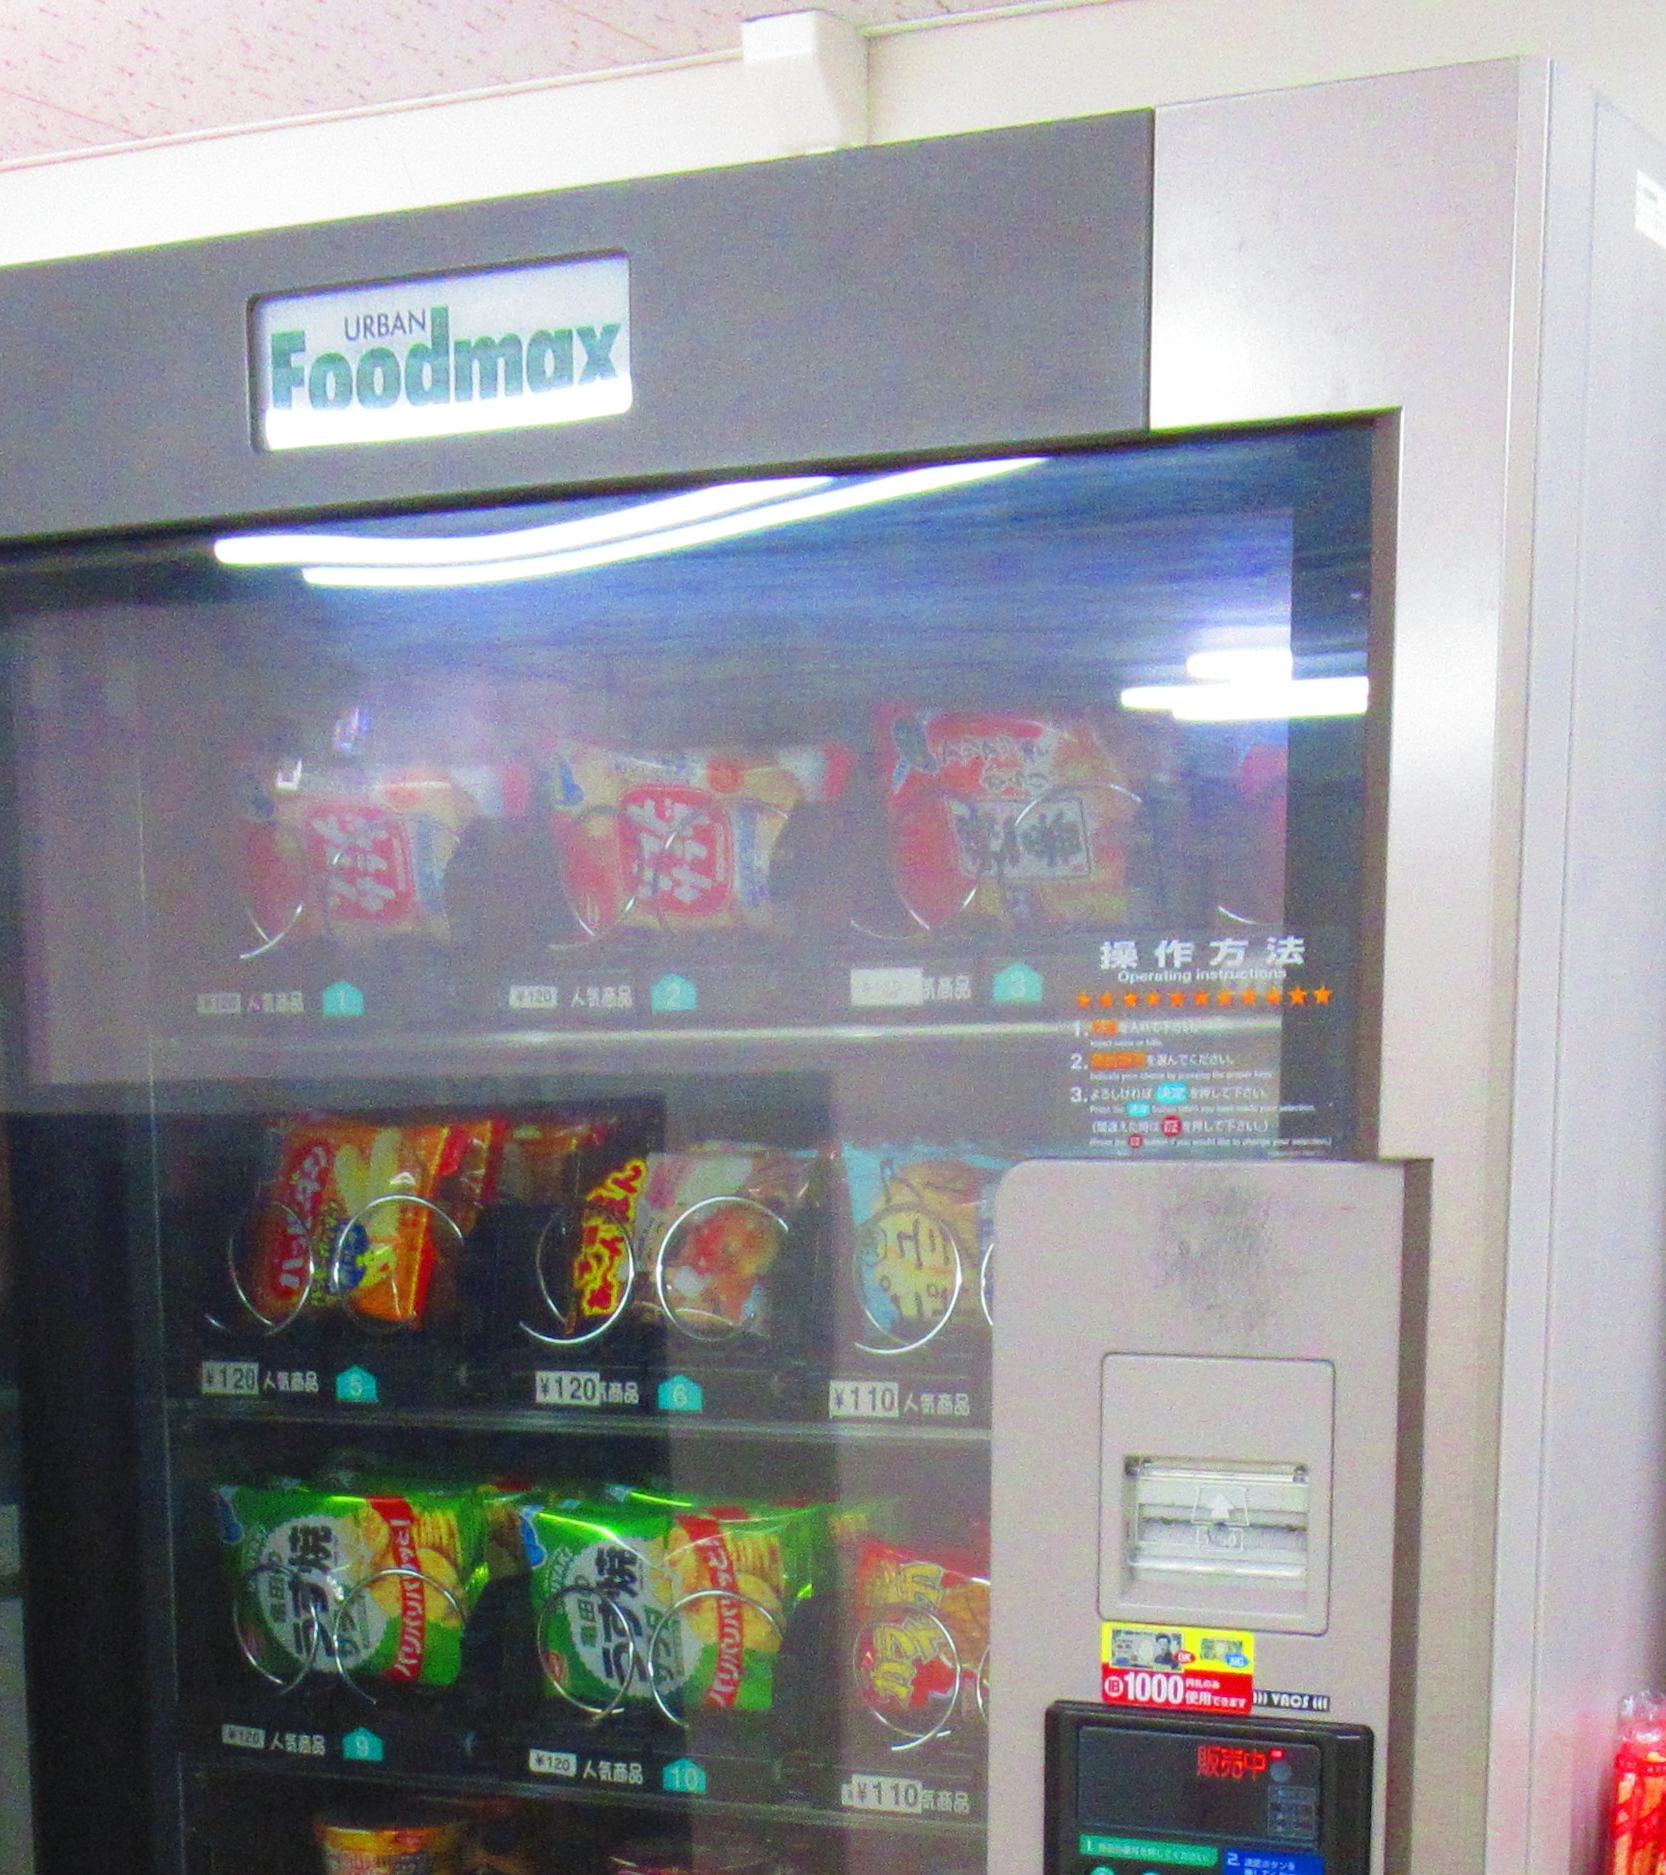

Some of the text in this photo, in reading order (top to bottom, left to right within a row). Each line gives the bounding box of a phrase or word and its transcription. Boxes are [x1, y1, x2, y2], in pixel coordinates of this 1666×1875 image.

[343, 309, 426, 342] URBAN
[271, 305, 621, 411] Foodmax
[1098, 935, 1307, 970] 操作方法
[1011, 973, 1026, 998] 3
[1117, 968, 1193, 984] Operating
[667, 982, 682, 1006] 2
[1070, 1053, 1089, 1072] 2.
[1070, 1086, 1089, 1104] 3.
[204, 1364, 256, 1391] ¥120
[538, 1376, 599, 1401] ¥120
[671, 1384, 688, 1405] 6
[833, 1386, 897, 1411] ¥110
[902, 1393, 971, 1416] 人気商品
[1124, 1672, 1185, 1704] 1000
[534, 1754, 573, 1772] ¥120
[582, 1761, 645, 1785] 人気商品
[1196, 1745, 1267, 1781] 販売中
[671, 1769, 700, 1790] 10
[856, 1781, 921, 1808] ¥110
